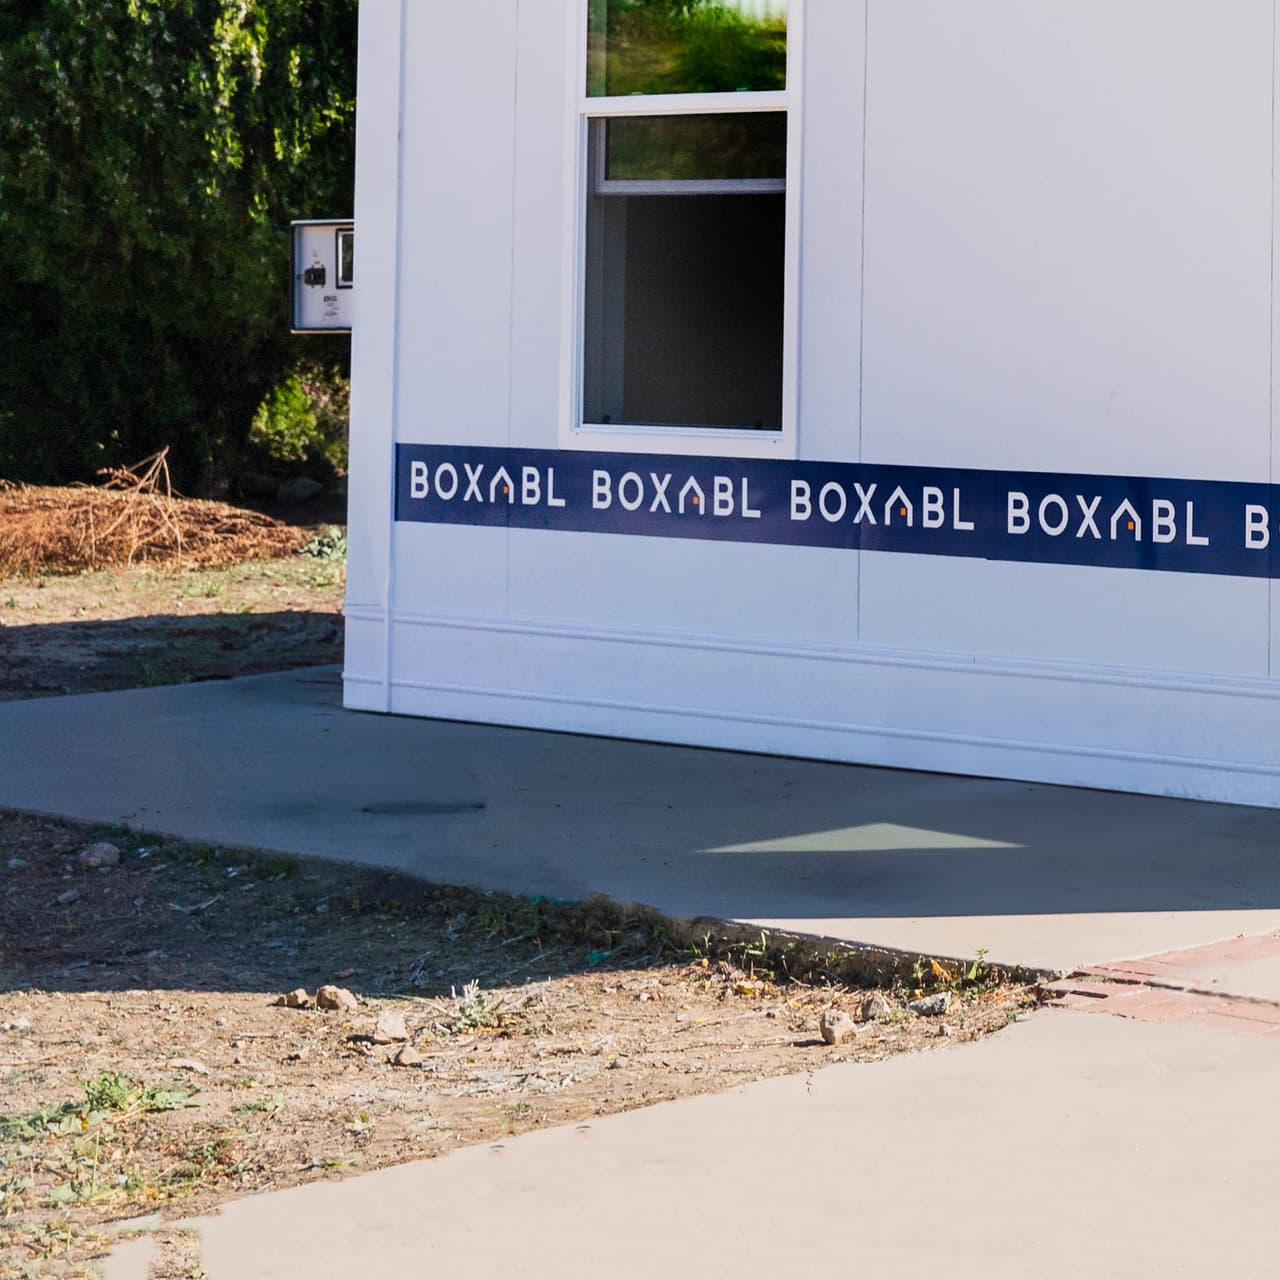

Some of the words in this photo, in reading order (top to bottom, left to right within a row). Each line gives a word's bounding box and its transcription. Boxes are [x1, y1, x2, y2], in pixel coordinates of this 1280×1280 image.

[411, 462, 566, 507] BOXABL
[593, 470, 761, 518] BOXABL
[791, 480, 975, 531] BOXABL
[1008, 492, 1209, 546] BOXABL
